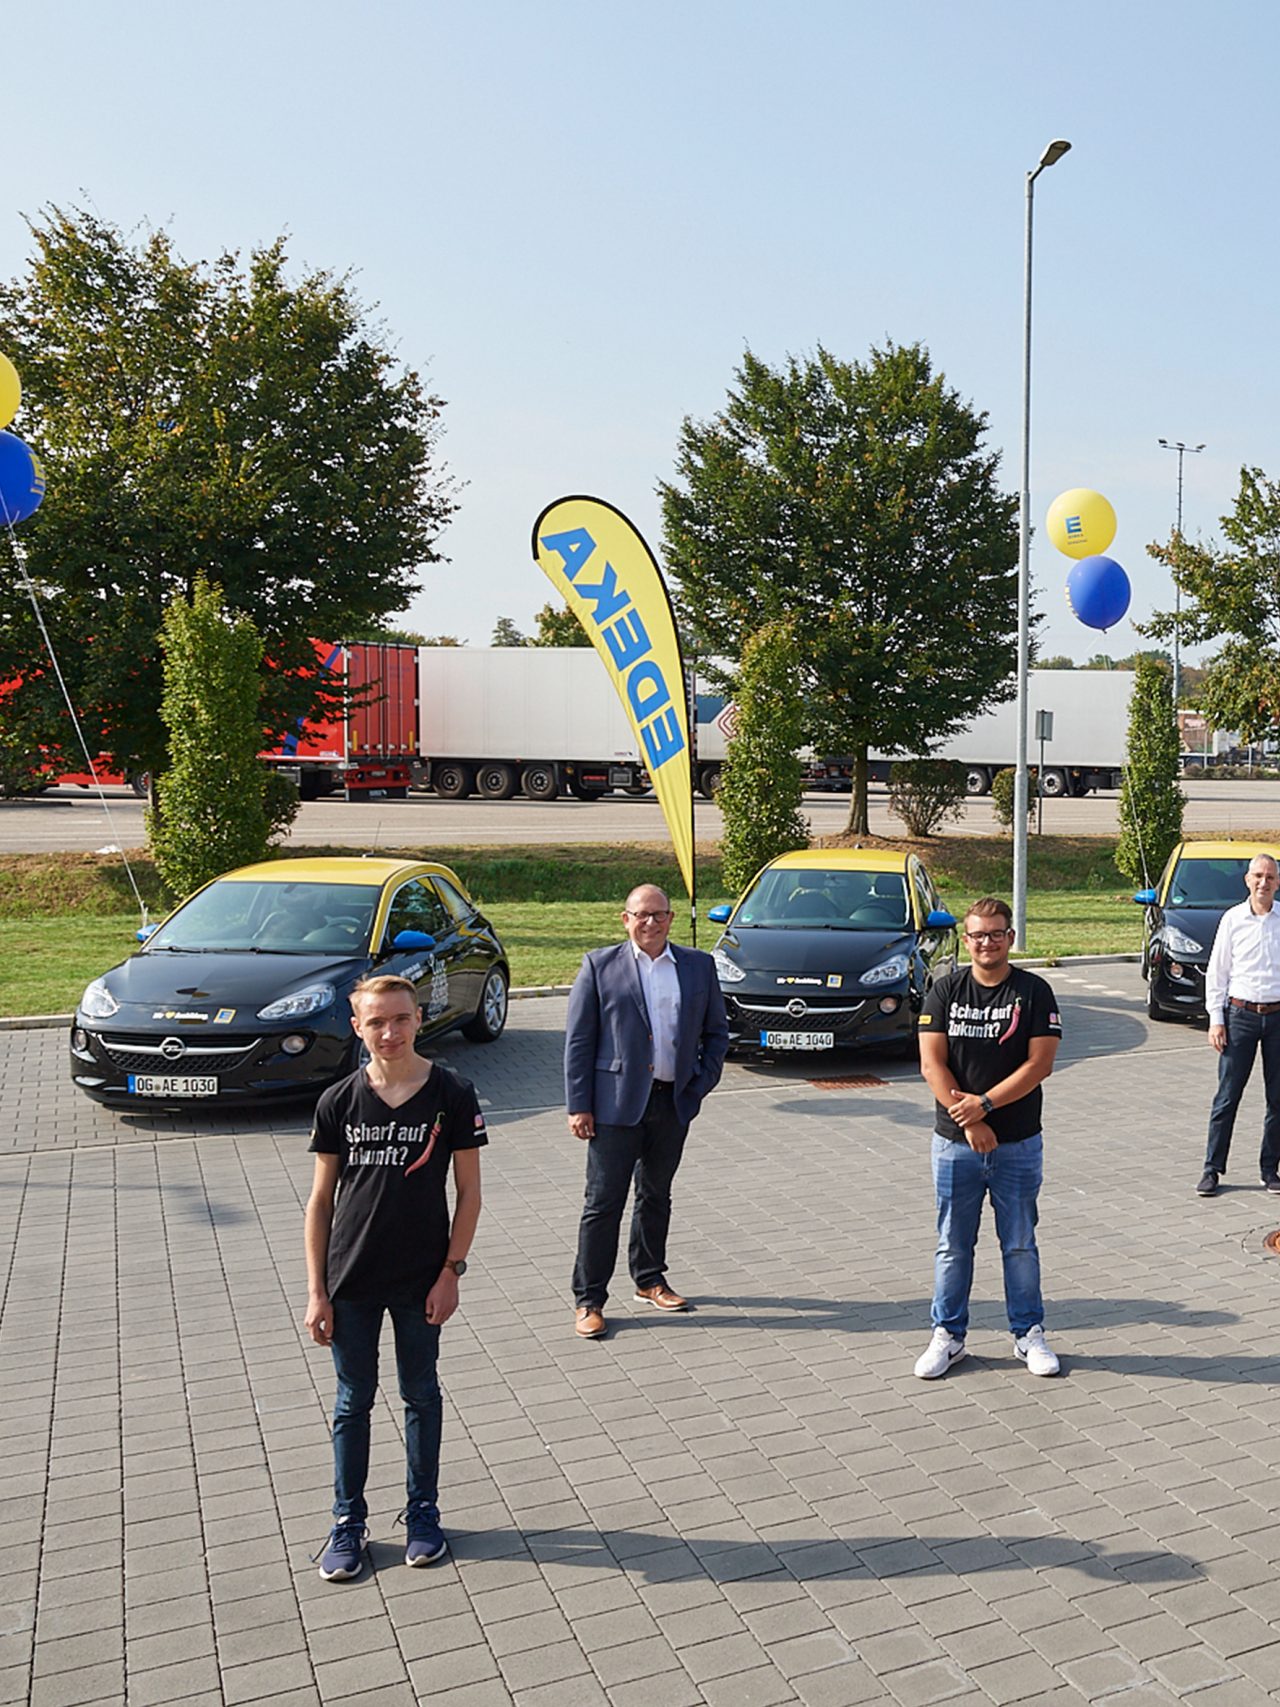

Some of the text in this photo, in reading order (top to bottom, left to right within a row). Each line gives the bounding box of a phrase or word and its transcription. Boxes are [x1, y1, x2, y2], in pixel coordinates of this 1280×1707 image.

[950, 1002, 1014, 1020] Scharf auf
[948, 1020, 1000, 1038] Zukunft?
[768, 1033, 832, 1046] OG AE 1040
[137, 1077, 215, 1092] OG AE 1030
[345, 1121, 428, 1143] Scharf auf
